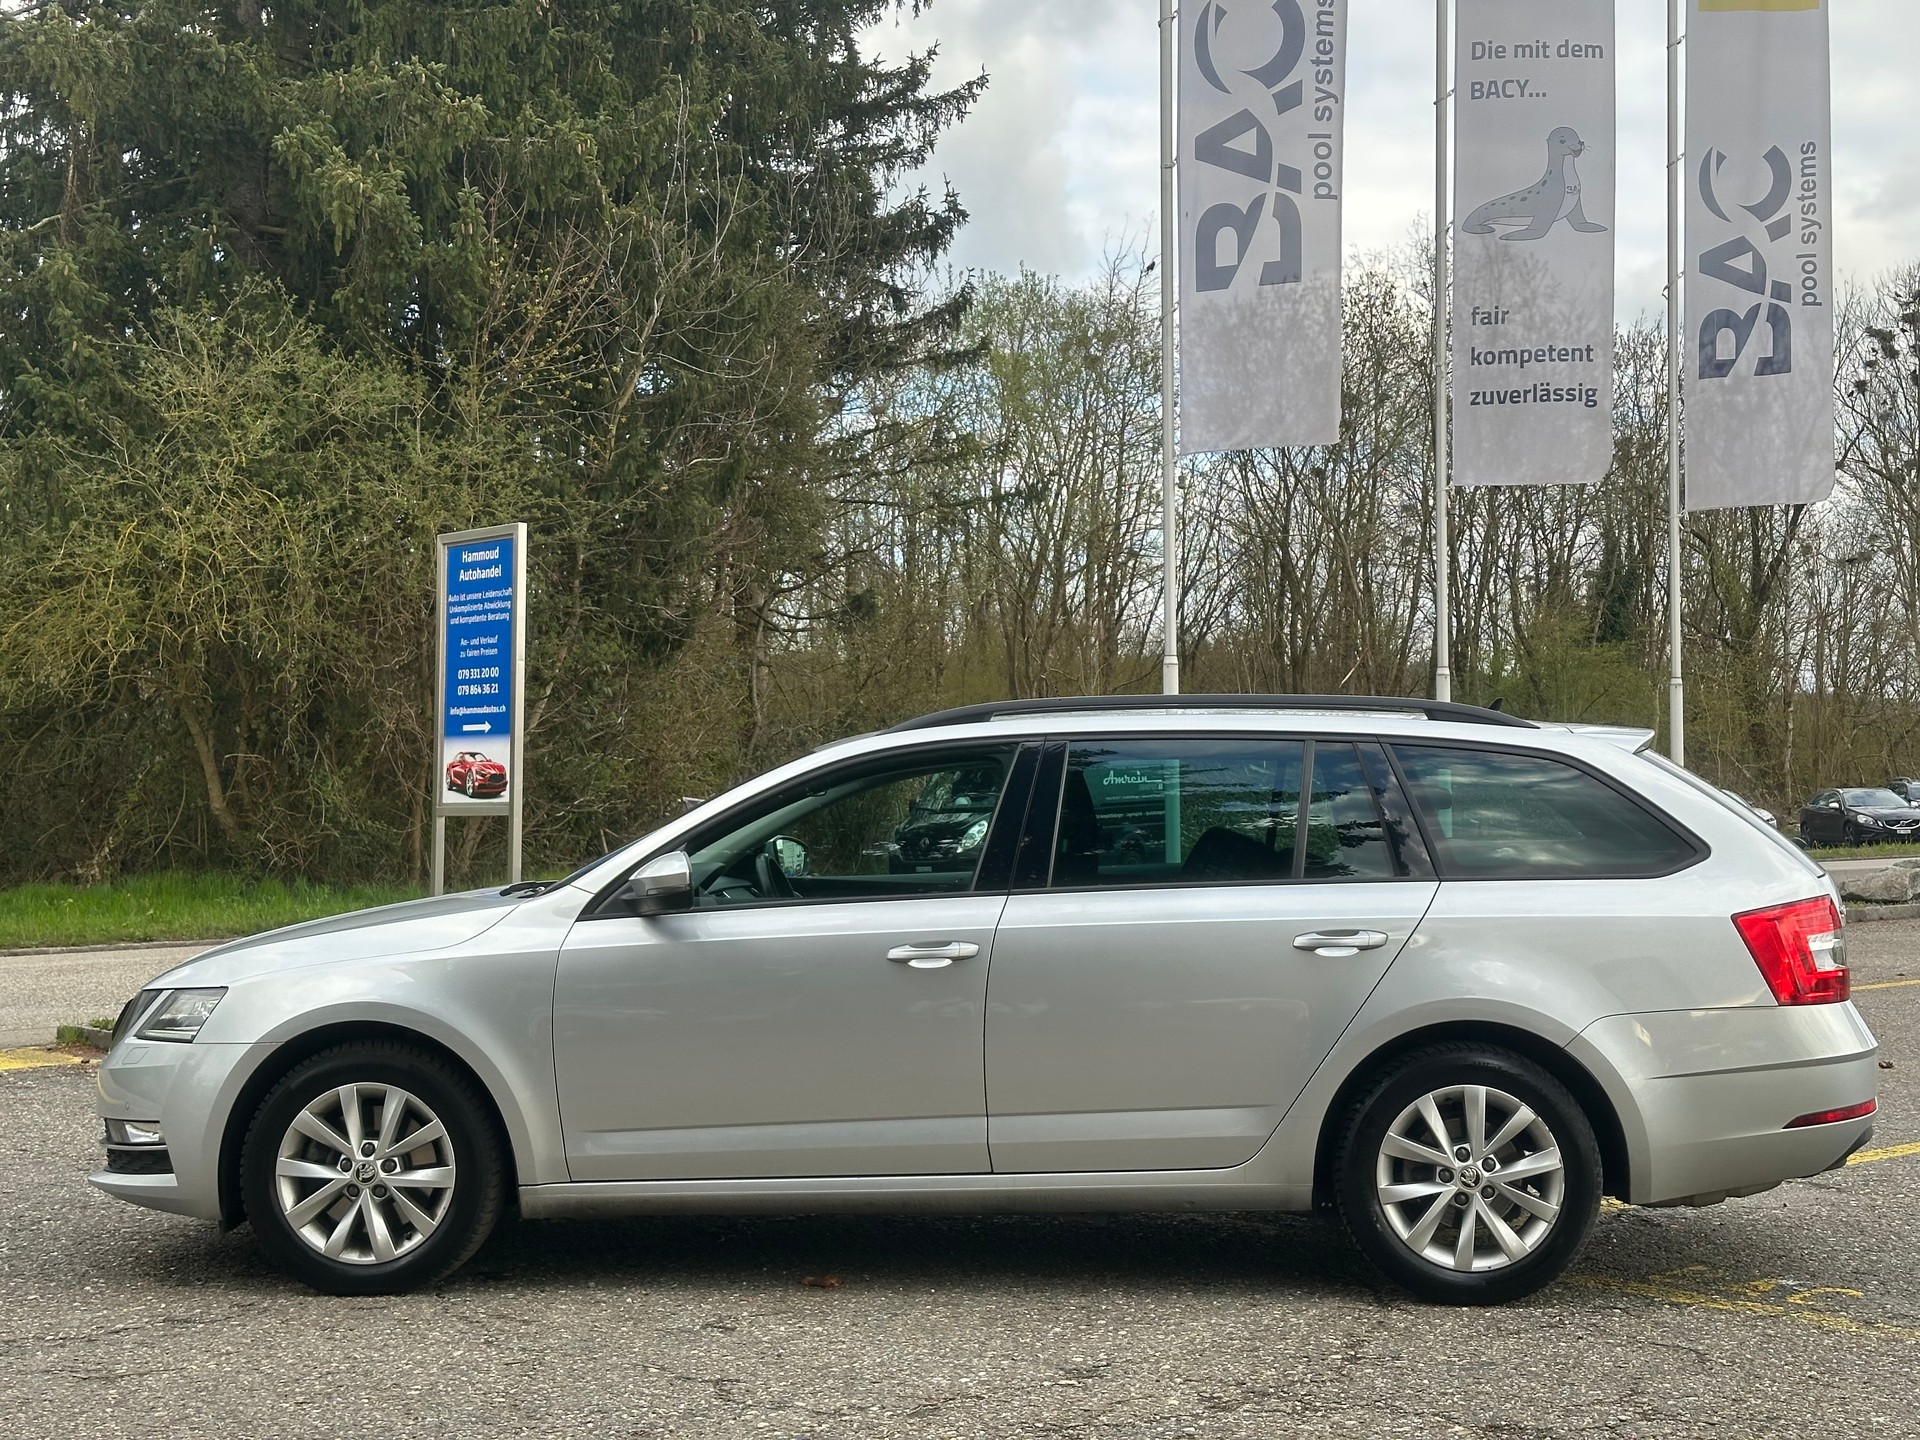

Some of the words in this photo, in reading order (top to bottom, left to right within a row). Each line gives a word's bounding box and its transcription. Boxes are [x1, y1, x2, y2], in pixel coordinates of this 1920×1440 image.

[1471, 40, 1506, 60] Die
[1513, 40, 1550, 59] mit
[1556, 39, 1604, 58] dem
[1470, 79, 1547, 100] BACY...
[1307, 133, 1338, 200] pool
[1796, 141, 1822, 244] systems
[1796, 253, 1822, 307] pool
[1471, 305, 1510, 326] fair
[1470, 344, 1594, 369] kompetent
[1470, 382, 1598, 408] zuverlässig
[462, 546, 500, 563] Hammoud
[459, 564, 502, 581] Autohandel
[448, 594, 459, 602] Auto
[467, 592, 482, 600] unsere
[482, 587, 513, 599] Leidenschaft
[484, 600, 511, 610] Abwicklung
[450, 616, 459, 625] und
[460, 613, 487, 624] kompetente
[488, 612, 510, 621] Beratung
[470, 637, 479, 645] und
[480, 635, 498, 644] Verkauf
[460, 650, 466, 658] zu
[467, 648, 480, 657] fairen
[480, 647, 498, 656] Preisen
[458, 669, 469, 680] 079
[470, 668, 480, 679] 331
[481, 667, 490, 678] 20
[490, 666, 500, 677] 00
[457, 685, 469, 696] 079
[470, 684, 481, 695] 864
[491, 683, 499, 693] 21
[1103, 770, 1157, 785] Amrein
